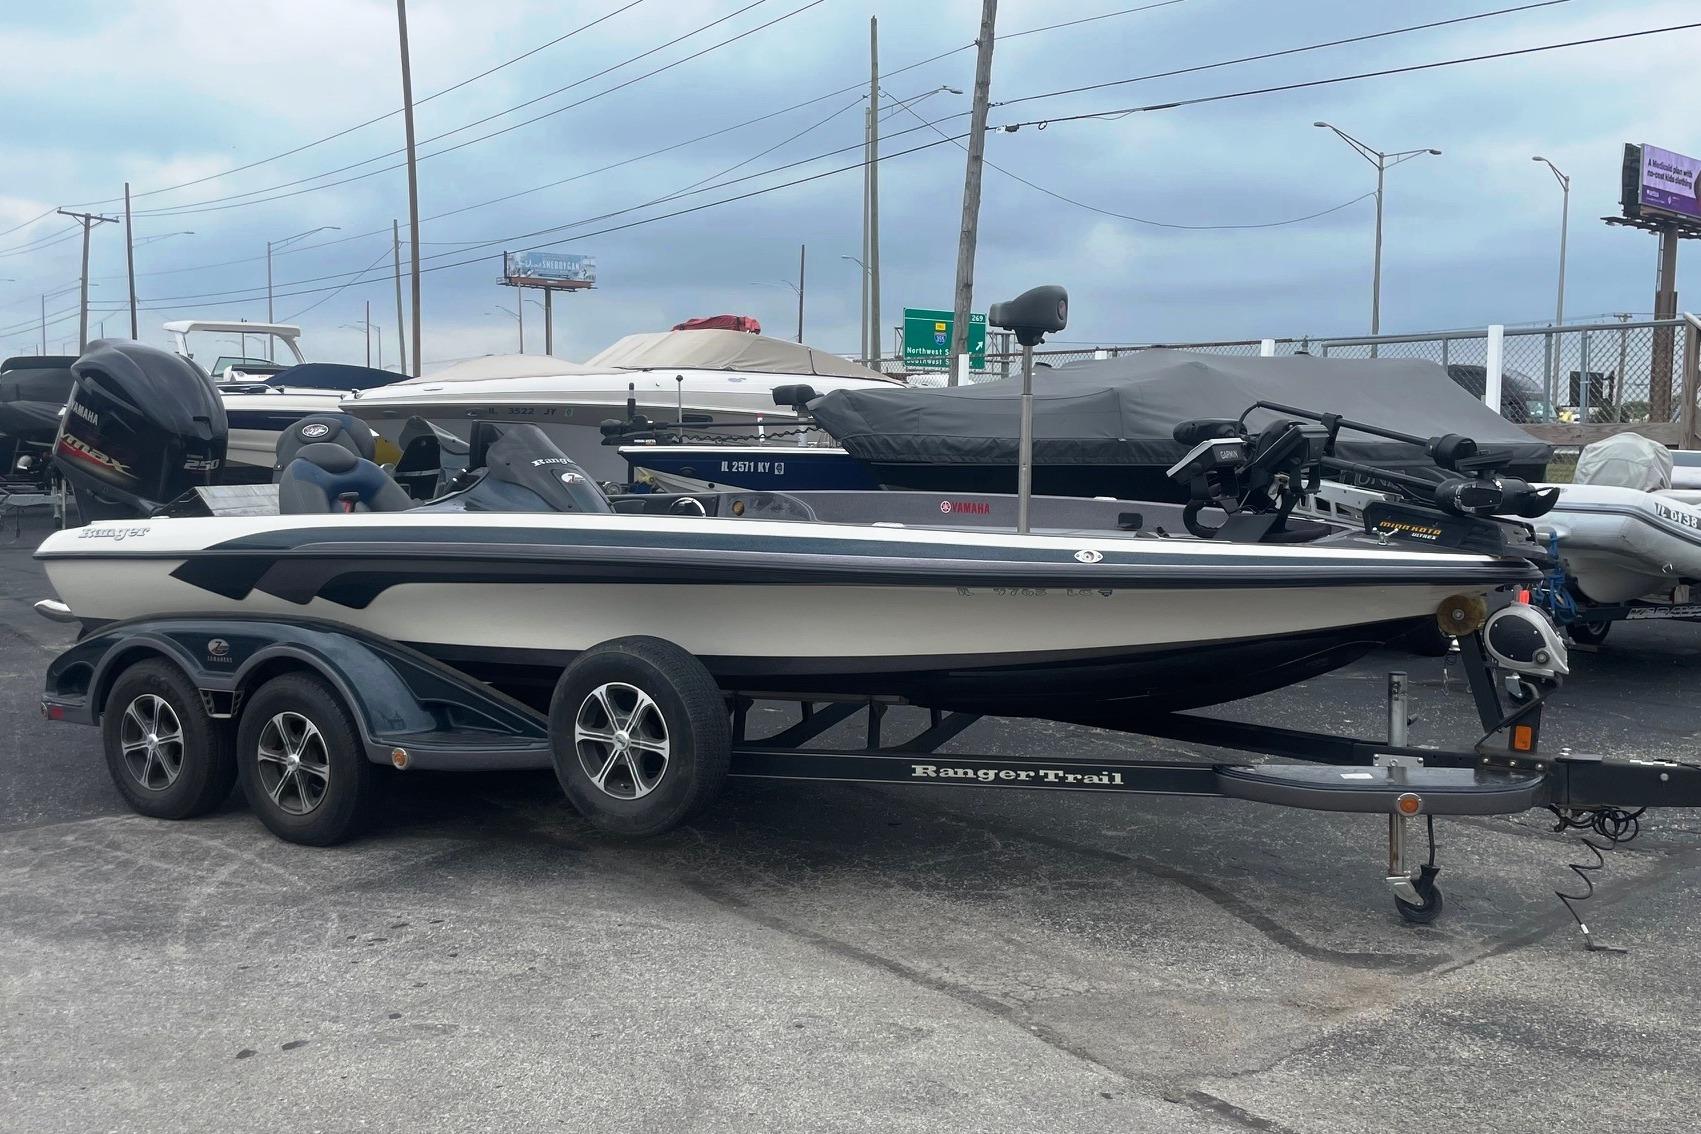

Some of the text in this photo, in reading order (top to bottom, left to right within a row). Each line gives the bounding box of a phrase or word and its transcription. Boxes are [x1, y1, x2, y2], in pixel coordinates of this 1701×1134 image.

[906, 347, 943, 355] Northwest
[508, 407, 535, 415] 3522
[184, 459, 220, 471] 250
[721, 461, 770, 473] IL 2571 KY
[952, 502, 990, 515] YAMAHA
[1670, 510, 1699, 528] 0138
[79, 527, 151, 541] Ranger
[1411, 532, 1437, 540] ULTREX
[911, 764, 1124, 785] Ranger Trail
